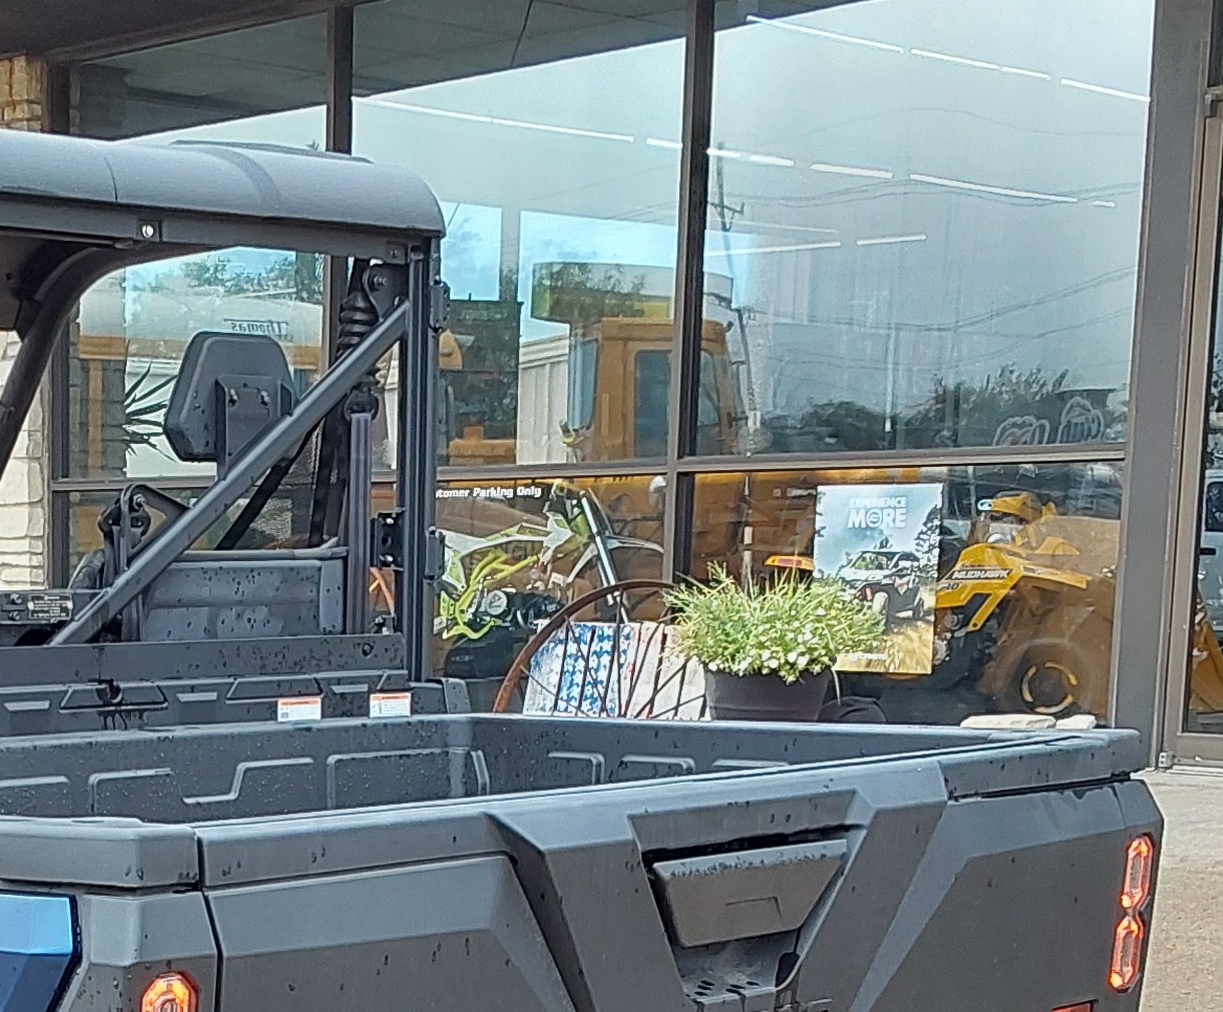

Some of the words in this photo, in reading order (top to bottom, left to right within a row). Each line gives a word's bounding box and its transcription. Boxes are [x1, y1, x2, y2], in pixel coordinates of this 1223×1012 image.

[472, 486, 513, 498] Parking
[516, 485, 542, 498] Only
[847, 507, 907, 529] MORE
